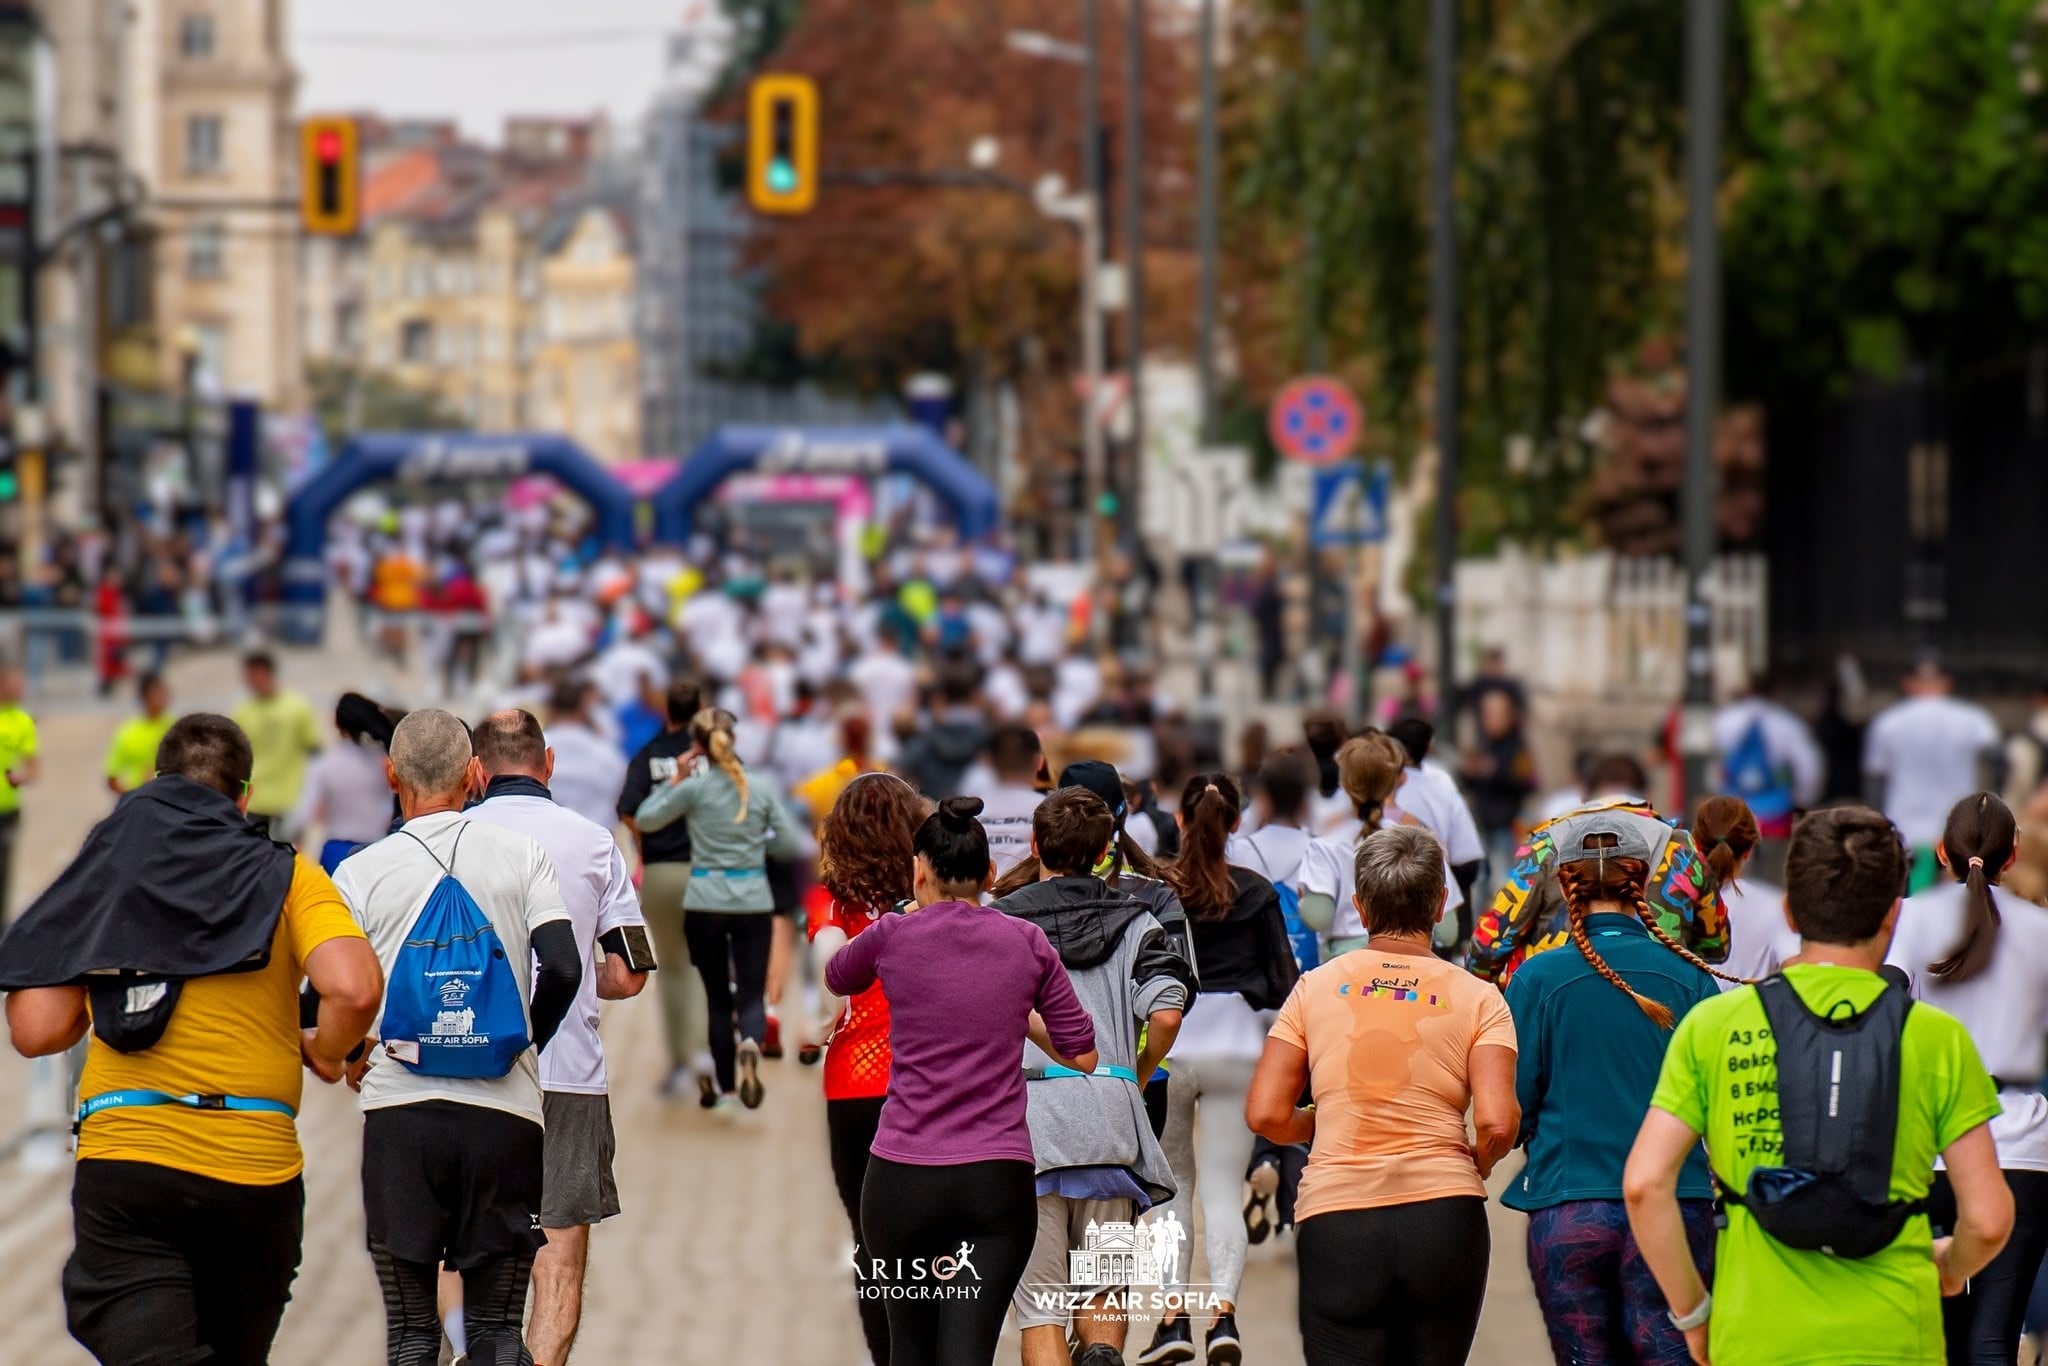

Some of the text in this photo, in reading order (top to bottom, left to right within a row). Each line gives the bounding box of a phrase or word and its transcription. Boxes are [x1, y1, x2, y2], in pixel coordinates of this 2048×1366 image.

[418, 1036, 489, 1045] WIZZ AIR SOFIA
